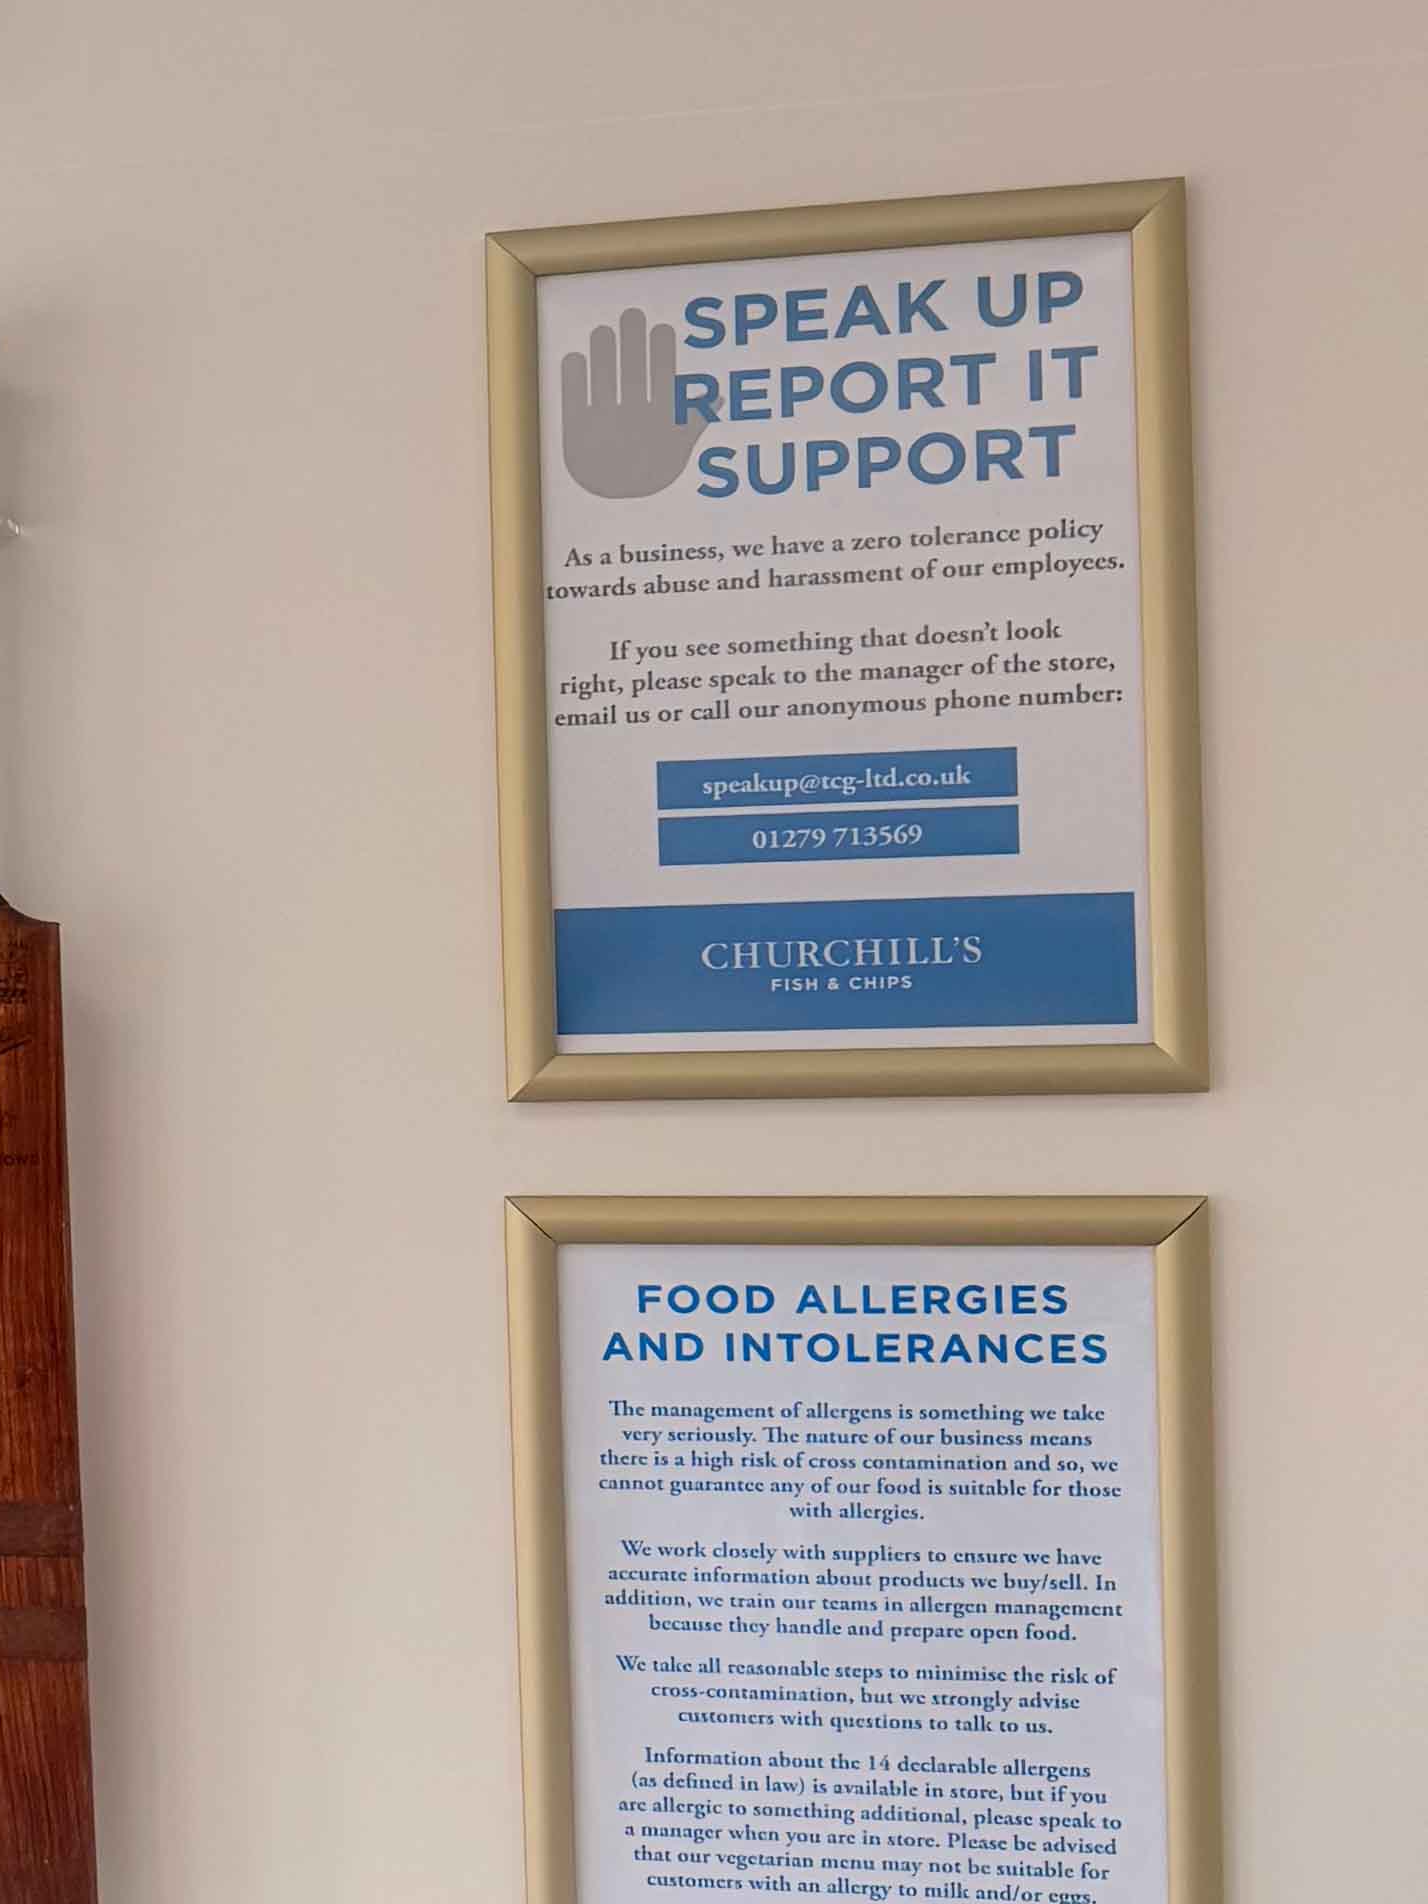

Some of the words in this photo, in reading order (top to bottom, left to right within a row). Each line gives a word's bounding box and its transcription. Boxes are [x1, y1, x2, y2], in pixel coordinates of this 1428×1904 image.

[683, 279, 950, 350] SPEAK
[976, 270, 1084, 328] UP
[674, 353, 996, 426] REPORT
[1028, 345, 1099, 402] IT
[696, 423, 1077, 499] SUPPORT
[563, 547, 593, 568] As
[599, 552, 613, 566] a
[619, 543, 725, 565] business,
[731, 543, 765, 558] we
[771, 534, 825, 556] have
[831, 538, 845, 552] a
[850, 535, 902, 551] zero
[910, 525, 1021, 548] tolerance
[1028, 518, 1104, 548] policy
[546, 577, 637, 600] towards
[643, 573, 711, 595] abuse
[716, 568, 761, 591] and
[767, 565, 903, 588] harassment
[910, 558, 939, 581] of
[941, 563, 985, 579] our
[991, 552, 1125, 582] employees.
[609, 639, 633, 661] If
[634, 644, 679, 666] you
[685, 642, 721, 657] see
[727, 630, 854, 656] something
[860, 626, 909, 649] that
[914, 621, 999, 646] doesn't
[1005, 618, 1063, 641] look
[559, 672, 624, 701] right,
[631, 670, 703, 699] please
[707, 664, 777, 695] speak
[783, 670, 807, 685] to
[815, 662, 853, 683] the
[859, 663, 965, 685] manager
[970, 655, 999, 676] of
[1002, 654, 1041, 675] the
[1047, 656, 1116, 673] store,
[554, 703, 617, 727] email
[625, 710, 651, 724] us
[657, 708, 684, 723] or
[689, 699, 731, 721] call
[738, 704, 781, 719] our
[786, 697, 927, 721] anonymous
[934, 689, 1012, 718] phone
[1017, 684, 1123, 707] number:
[702, 764, 972, 801] speakup@tcg-ltd.co.uk
[751, 828, 827, 849] 01279
[831, 823, 923, 848] 713569
[701, 935, 982, 970] CHURCHILL'S
[770, 977, 818, 993] FISH
[827, 977, 840, 991] &
[848, 975, 913, 990] CHIPS
[637, 1284, 775, 1315] FOOD
[795, 1284, 1068, 1315] ALLERGIES
[601, 1331, 705, 1362] AND
[725, 1332, 1108, 1365] INTOLERANCES
[608, 1399, 646, 1417] The
[651, 1405, 775, 1424] management
[780, 1400, 803, 1419] of
[805, 1401, 893, 1425] allergens
[898, 1403, 913, 1420] is
[919, 1402, 1025, 1427] something
[1029, 1409, 1057, 1421] we
[1062, 1403, 1105, 1422] take
[621, 1430, 663, 1447] very
[667, 1425, 758, 1448] seriously.
[761, 1425, 800, 1444] The
[805, 1431, 869, 1445] nature
[873, 1427, 897, 1445] of
[899, 1433, 936, 1445] our
[939, 1427, 1024, 1446] business
[1029, 1434, 1093, 1447] means
[599, 1448, 649, 1466] there
[653, 1450, 669, 1467] is
[674, 1455, 686, 1467] a
[691, 1449, 735, 1473] high
[740, 1450, 779, 1468] risk
[782, 1450, 806, 1469] of
[808, 1457, 857, 1469] cross
[862, 1454, 1007, 1471] contamination
[1013, 1453, 1051, 1472] and
[1056, 1460, 1085, 1474] so,
[1090, 1460, 1119, 1473] we
